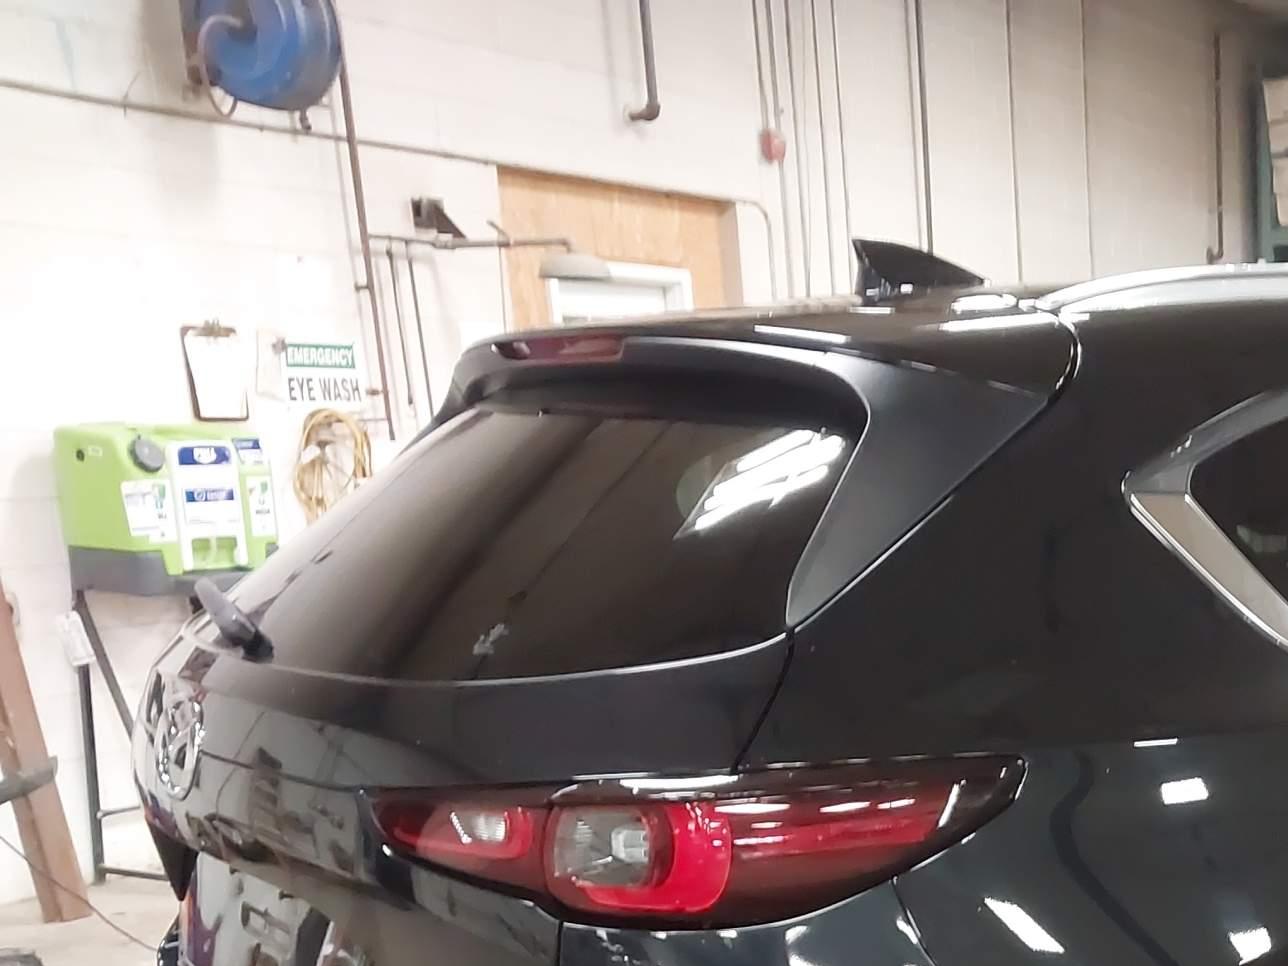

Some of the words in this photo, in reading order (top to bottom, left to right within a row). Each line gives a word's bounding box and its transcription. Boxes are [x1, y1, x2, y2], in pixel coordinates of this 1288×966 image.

[287, 345, 352, 367] EMERGENCY
[287, 377, 316, 401] EYE
[319, 377, 362, 402] WASH
